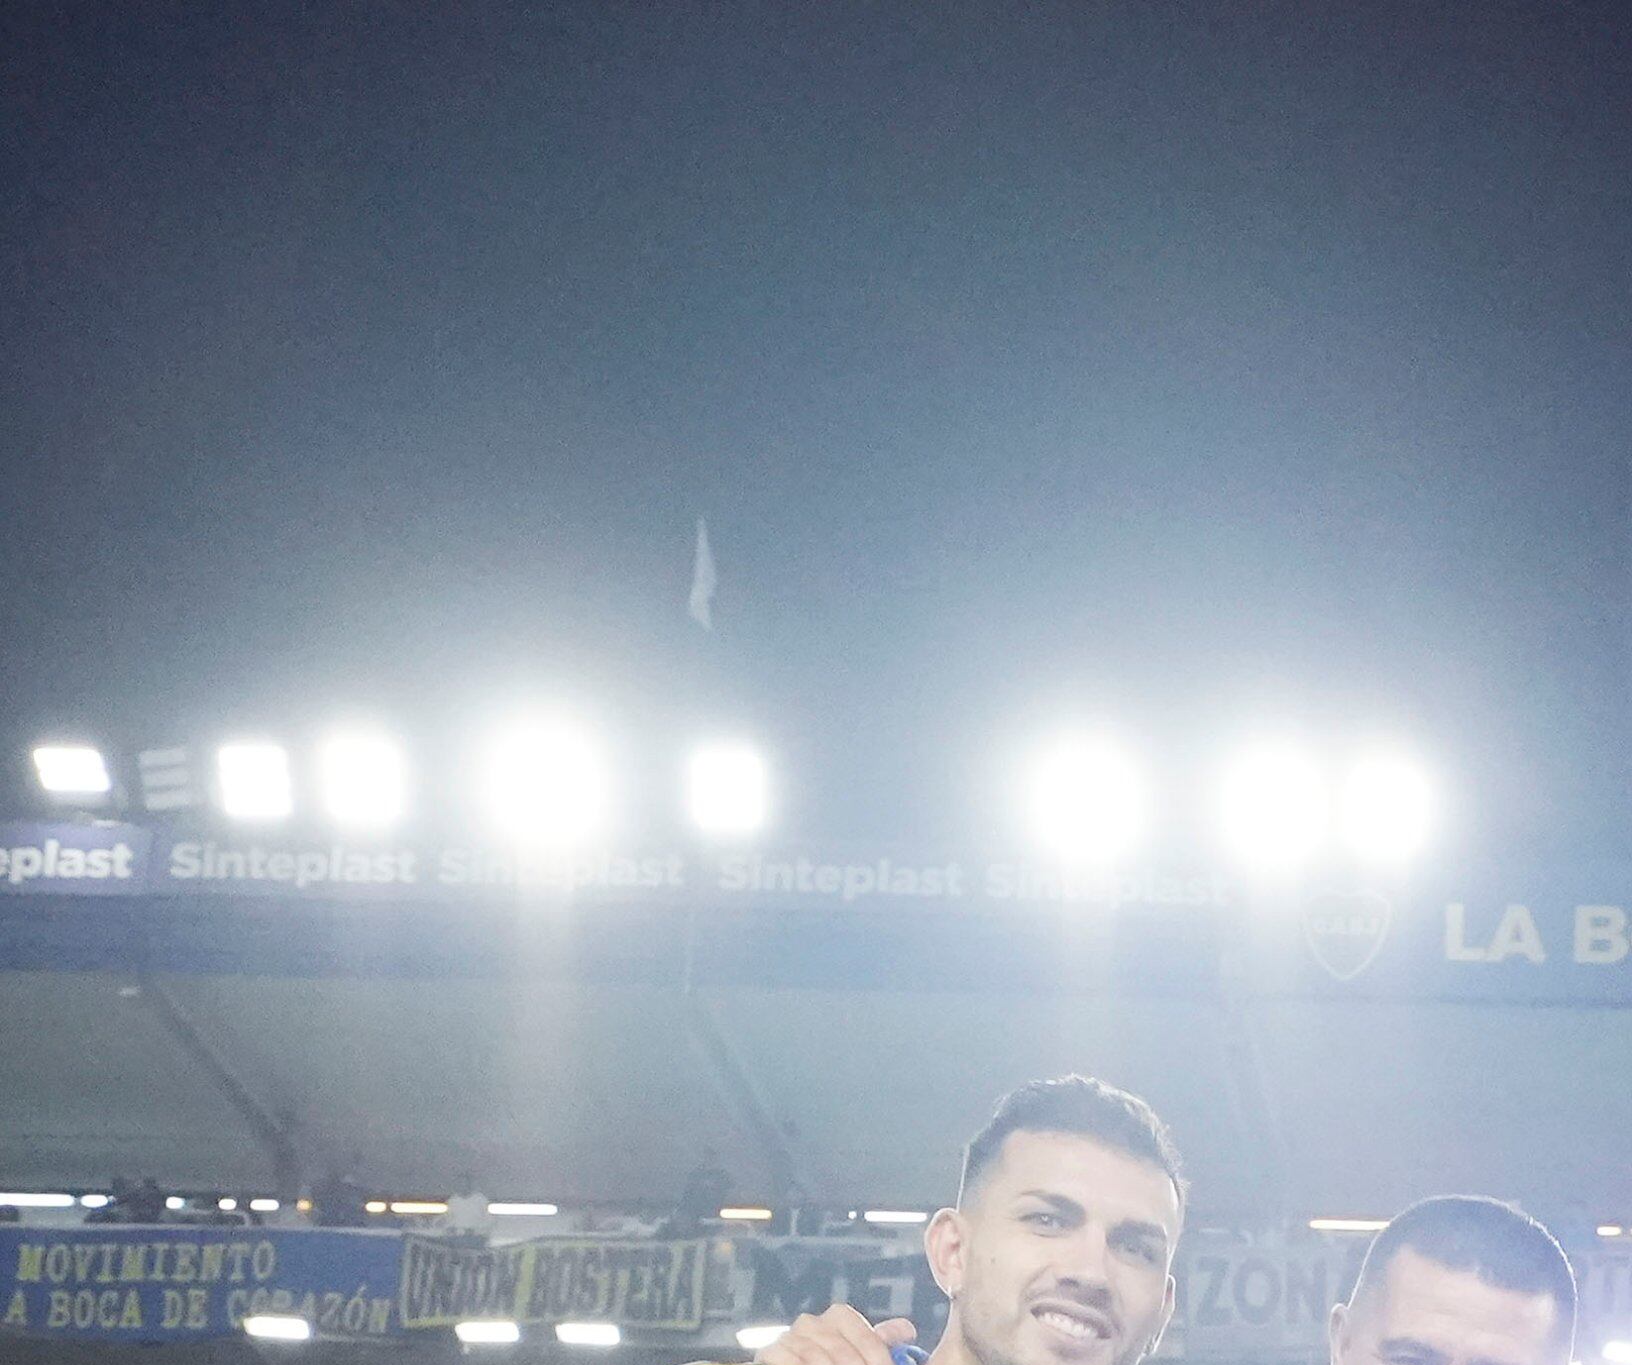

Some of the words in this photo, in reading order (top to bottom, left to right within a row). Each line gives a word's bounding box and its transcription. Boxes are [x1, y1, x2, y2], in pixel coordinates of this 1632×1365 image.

[169, 841, 417, 887] Sinteplast
[717, 853, 962, 900] Sinteplast
[1444, 903, 1546, 963] LA
[16, 1239, 278, 1282] MOVIMIENTO
[47, 1288, 143, 1329] BOCA
[161, 1288, 208, 1329] DE
